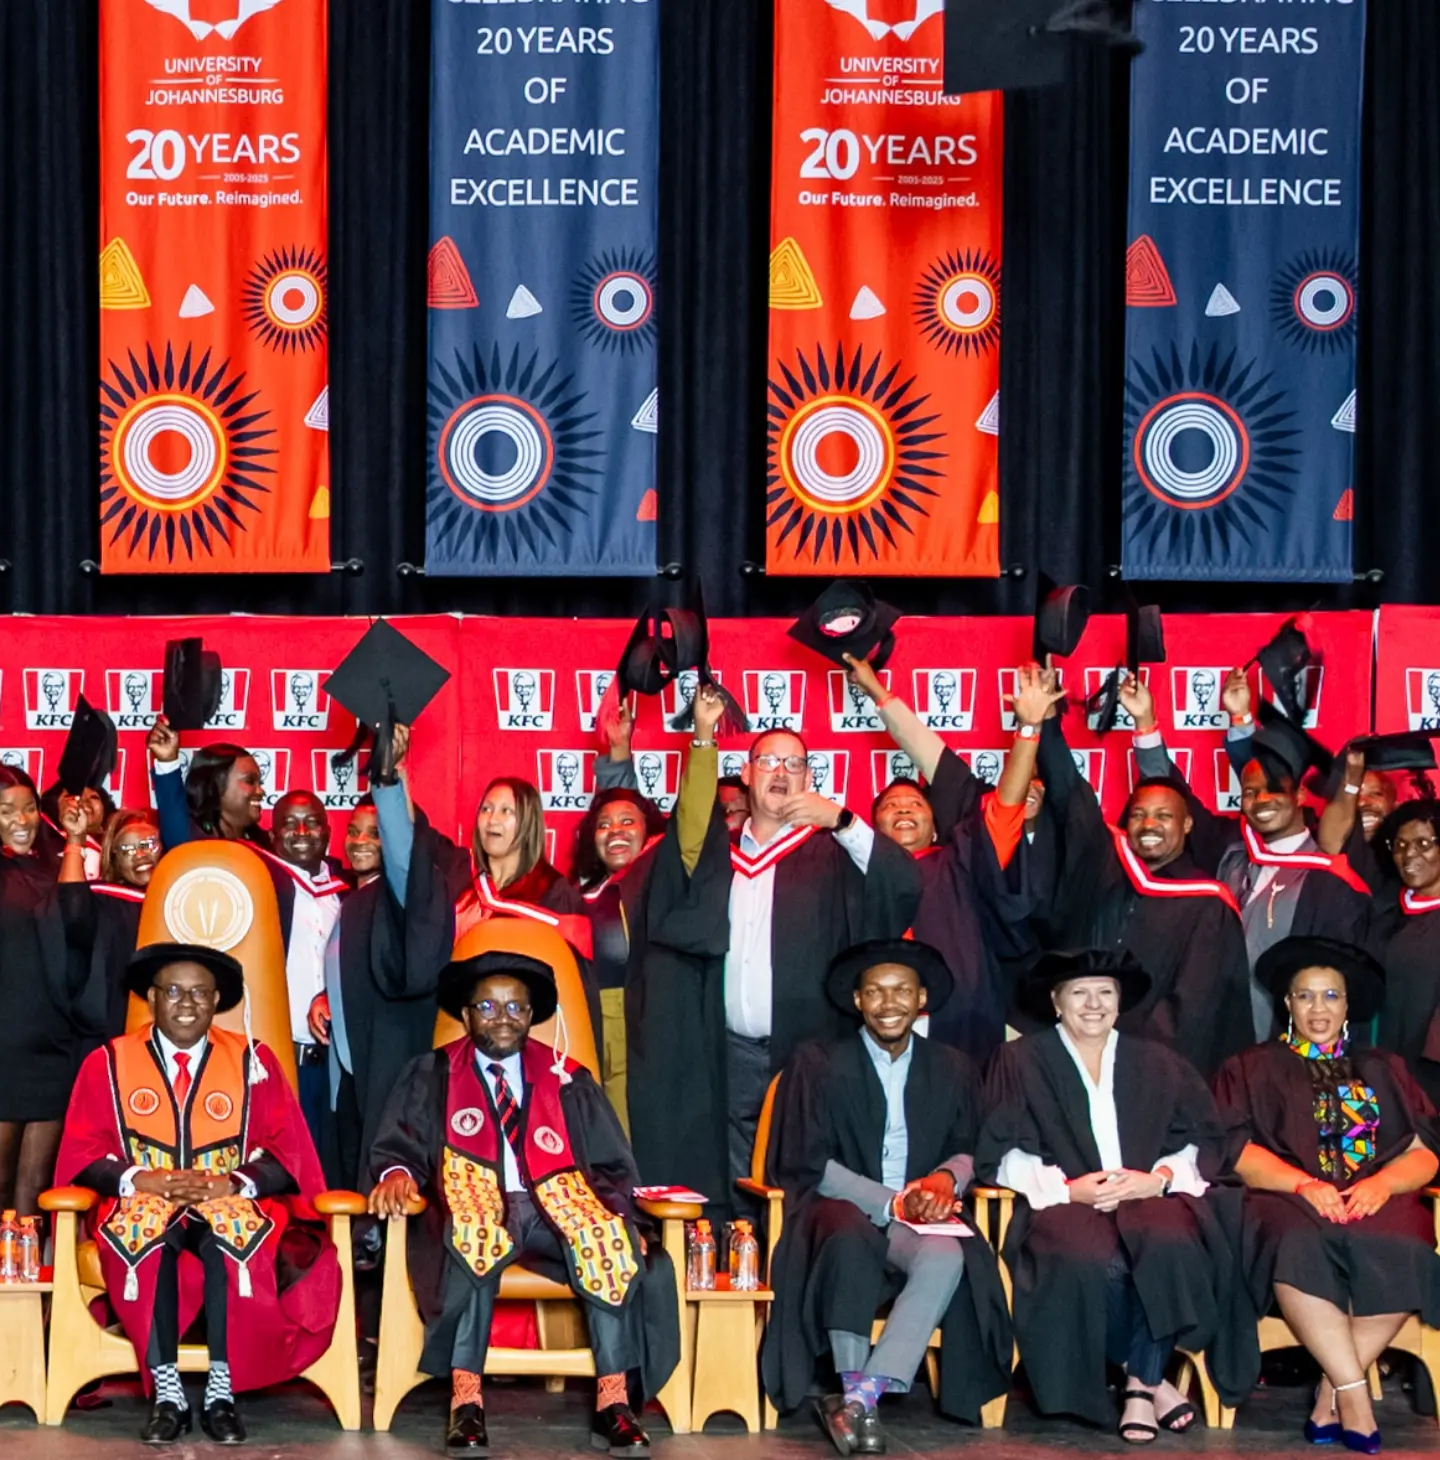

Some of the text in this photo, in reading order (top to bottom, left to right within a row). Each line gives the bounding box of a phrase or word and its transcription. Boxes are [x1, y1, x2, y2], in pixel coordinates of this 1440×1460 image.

[477, 27, 614, 54] 20 YEARS
[1179, 26, 1319, 54] 20 YEARS
[164, 56, 262, 74] UNIVERSITY
[840, 57, 939, 74] UNIVERSITY
[206, 75, 223, 85] OF
[882, 75, 899, 86] OF
[145, 88, 284, 106] JOHANNESBURG
[524, 76, 567, 104] OF
[1225, 77, 1269, 104] OF
[463, 128, 625, 156] ACADEMIC
[1163, 127, 1328, 155] ACADEMIC
[126, 129, 301, 180] 20 YEARS
[799, 128, 978, 180] 20 YEARS
[126, 190, 303, 208] Our Future. Reimagined.
[451, 178, 639, 206] EXCELLENCE
[798, 191, 980, 210] Our Future. Reimagined.
[1150, 177, 1342, 206] EXCELLENCE
[36, 714, 72, 726] KFC
[118, 714, 155, 727] KFC
[282, 715, 319, 727] KFC
[508, 715, 544, 727] KFC
[757, 716, 794, 729] KFC
[841, 716, 879, 728] KFC
[927, 715, 964, 728] KFC
[1183, 714, 1222, 727] KFC
[549, 796, 586, 808] KFC
